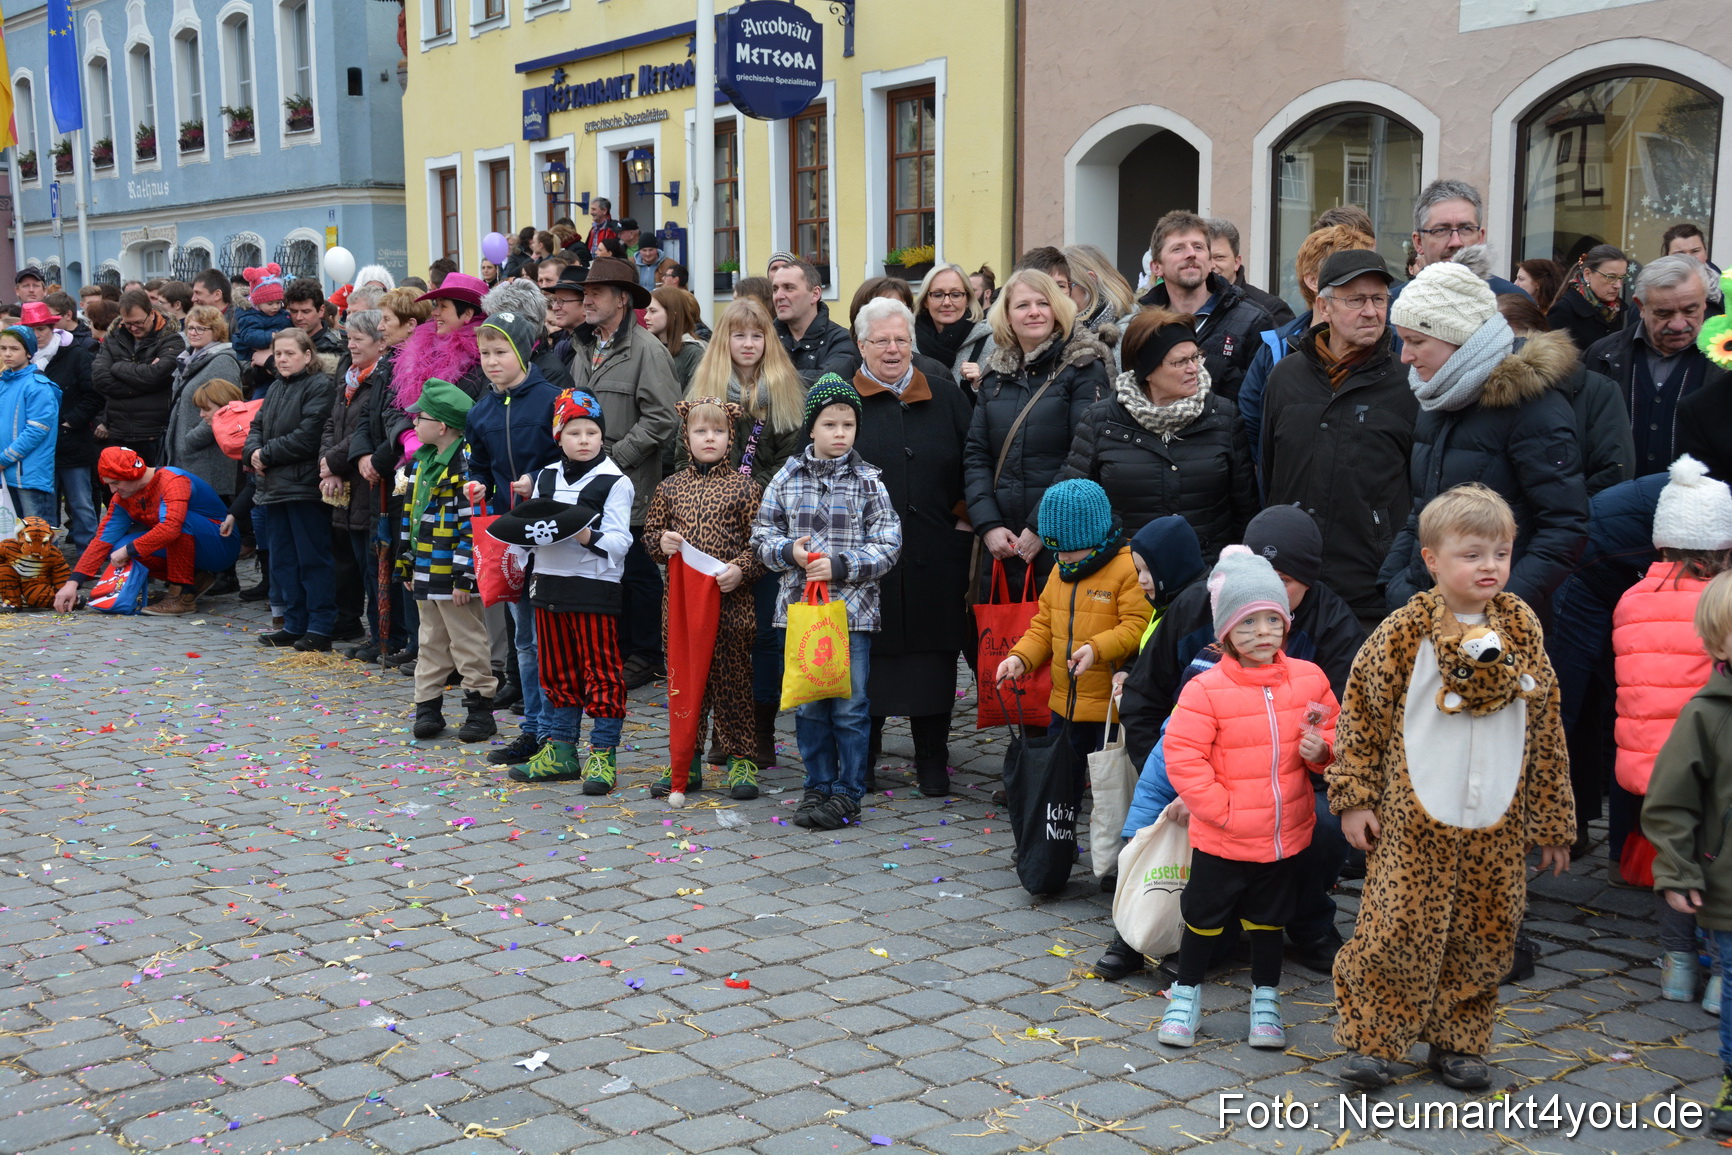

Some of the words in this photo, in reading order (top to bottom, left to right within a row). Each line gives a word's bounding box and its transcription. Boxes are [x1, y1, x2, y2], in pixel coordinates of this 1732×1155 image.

[740, 16, 812, 43] Arcobräu
[736, 42, 817, 70] METEORA
[546, 73, 635, 113] RESTAURANT
[637, 59, 696, 97] METEOR
[736, 73, 775, 84] griechische
[775, 76, 817, 87] Spezialitäten
[127, 180, 170, 200] Rathaus
[1046, 802, 1063, 820] Ich
